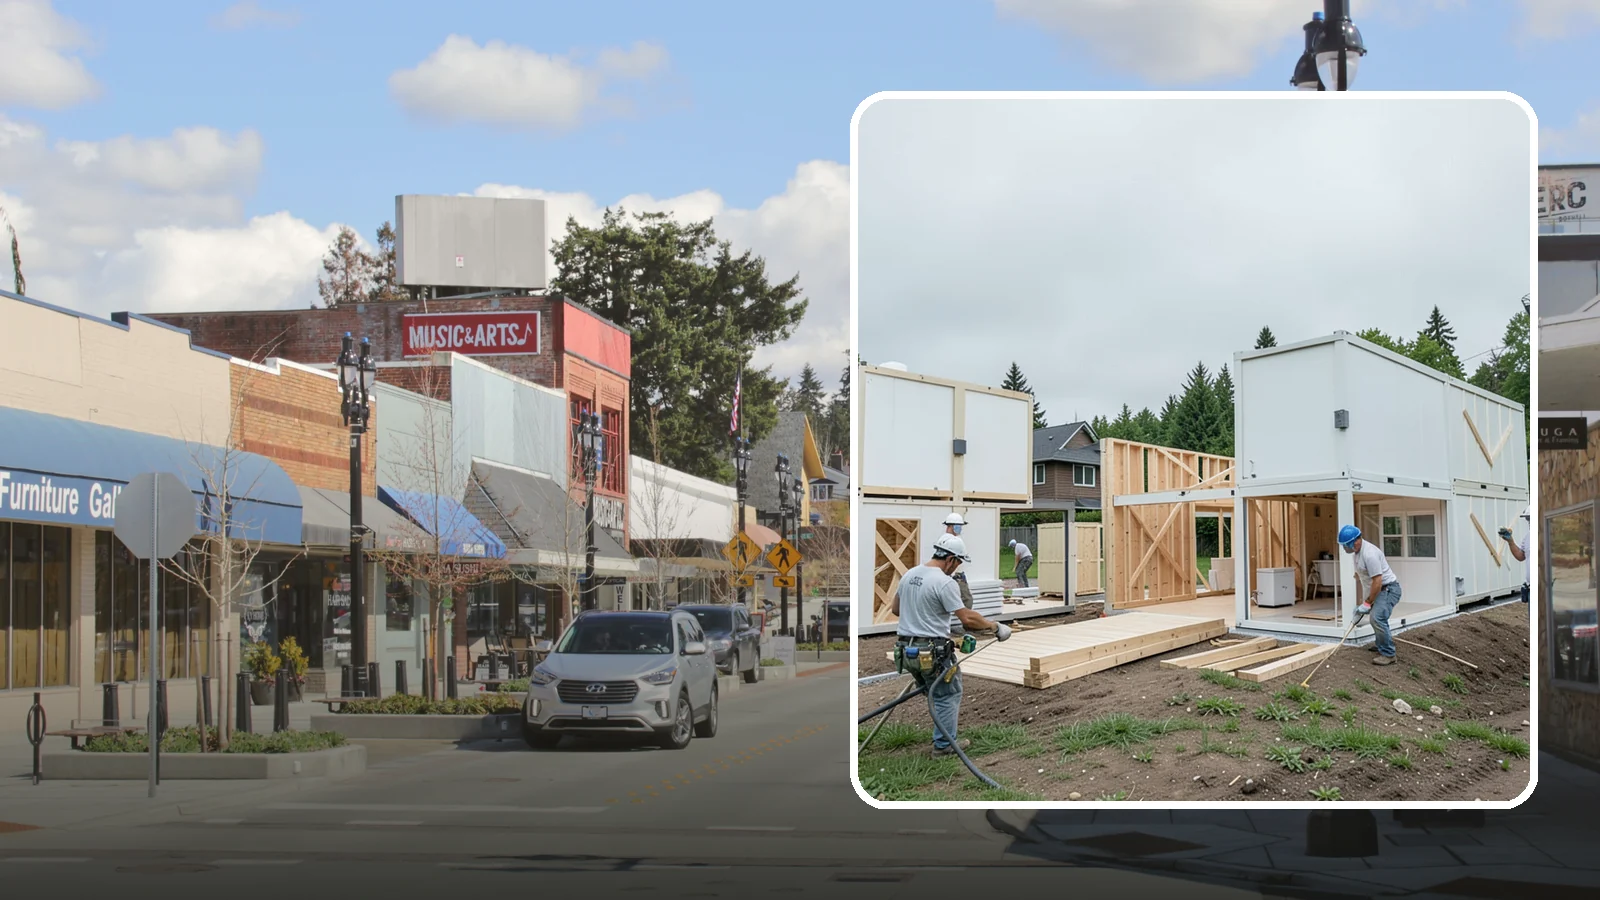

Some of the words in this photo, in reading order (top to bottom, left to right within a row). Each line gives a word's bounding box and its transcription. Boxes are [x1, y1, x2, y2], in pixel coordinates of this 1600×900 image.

[1540, 427, 1578, 437] UGA
[0, 471, 80, 516] Furniture
[453, 563, 479, 574] SUSHI
